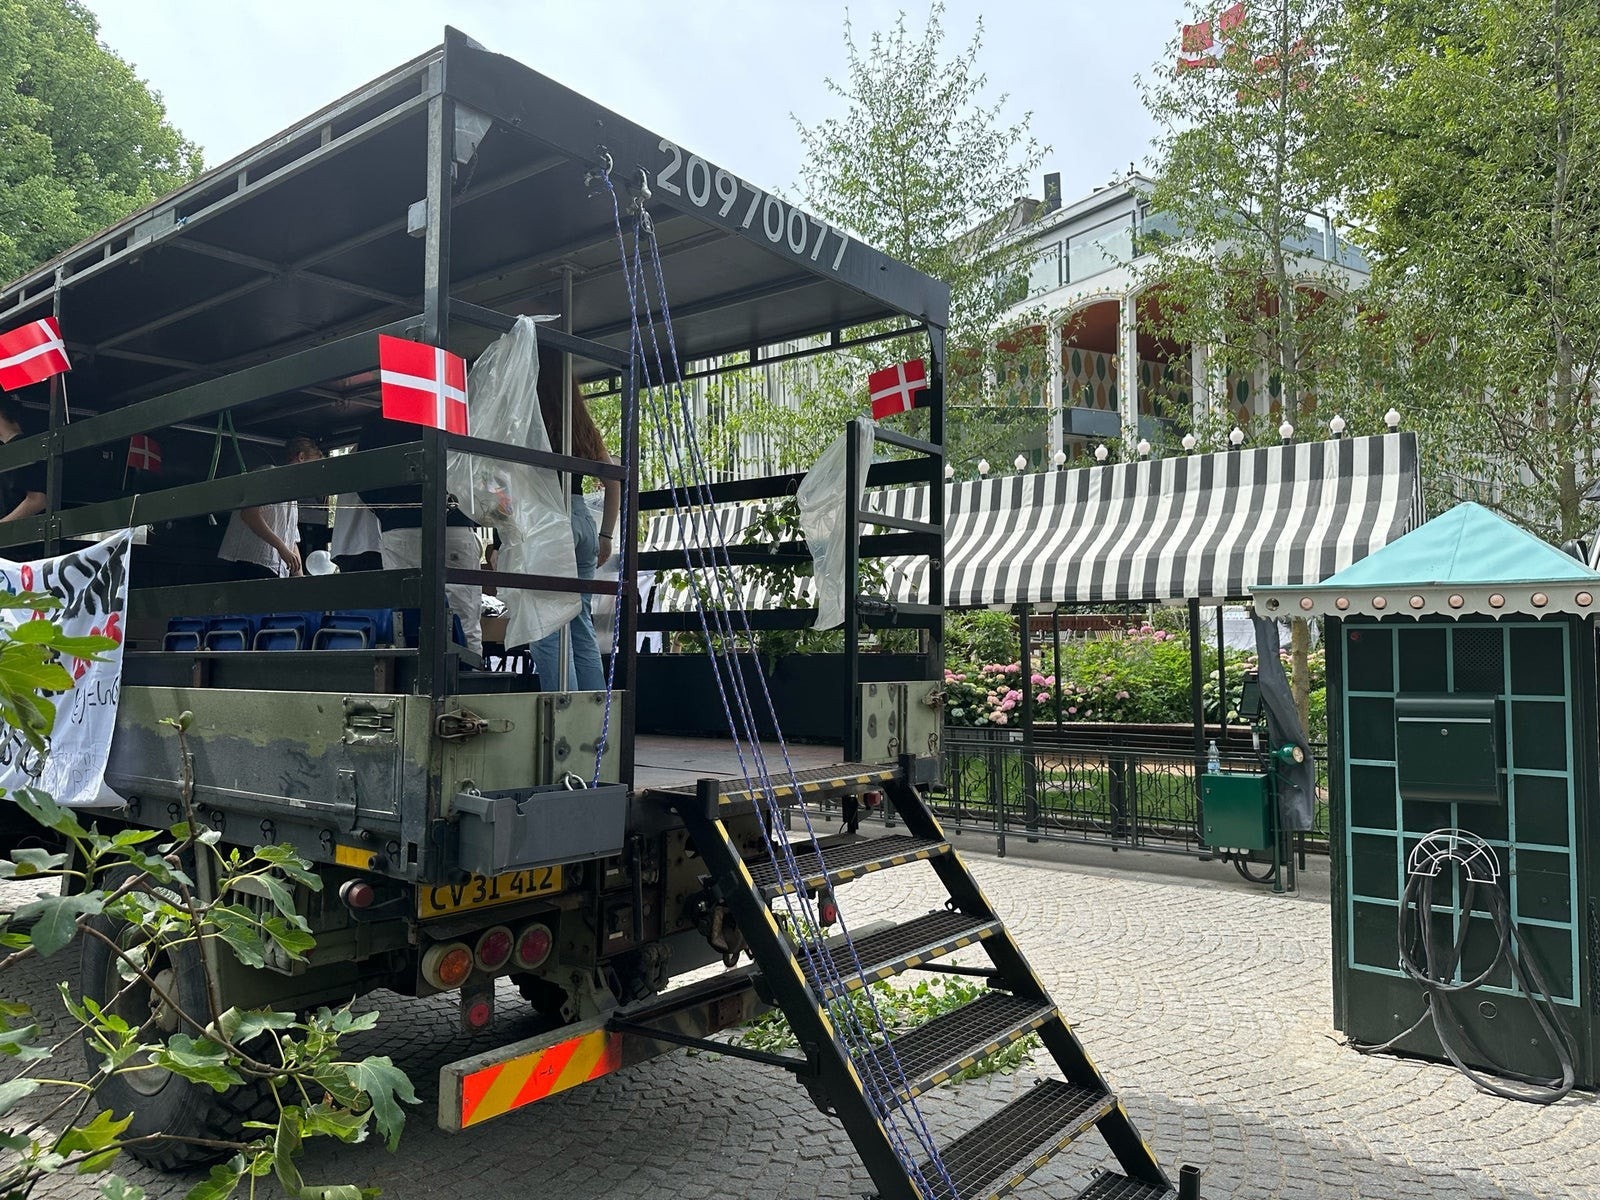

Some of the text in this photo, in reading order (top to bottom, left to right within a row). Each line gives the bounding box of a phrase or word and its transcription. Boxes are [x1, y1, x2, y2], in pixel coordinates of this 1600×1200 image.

[656, 139, 849, 271] 20970077
[430, 866, 554, 910] CV 31 412
